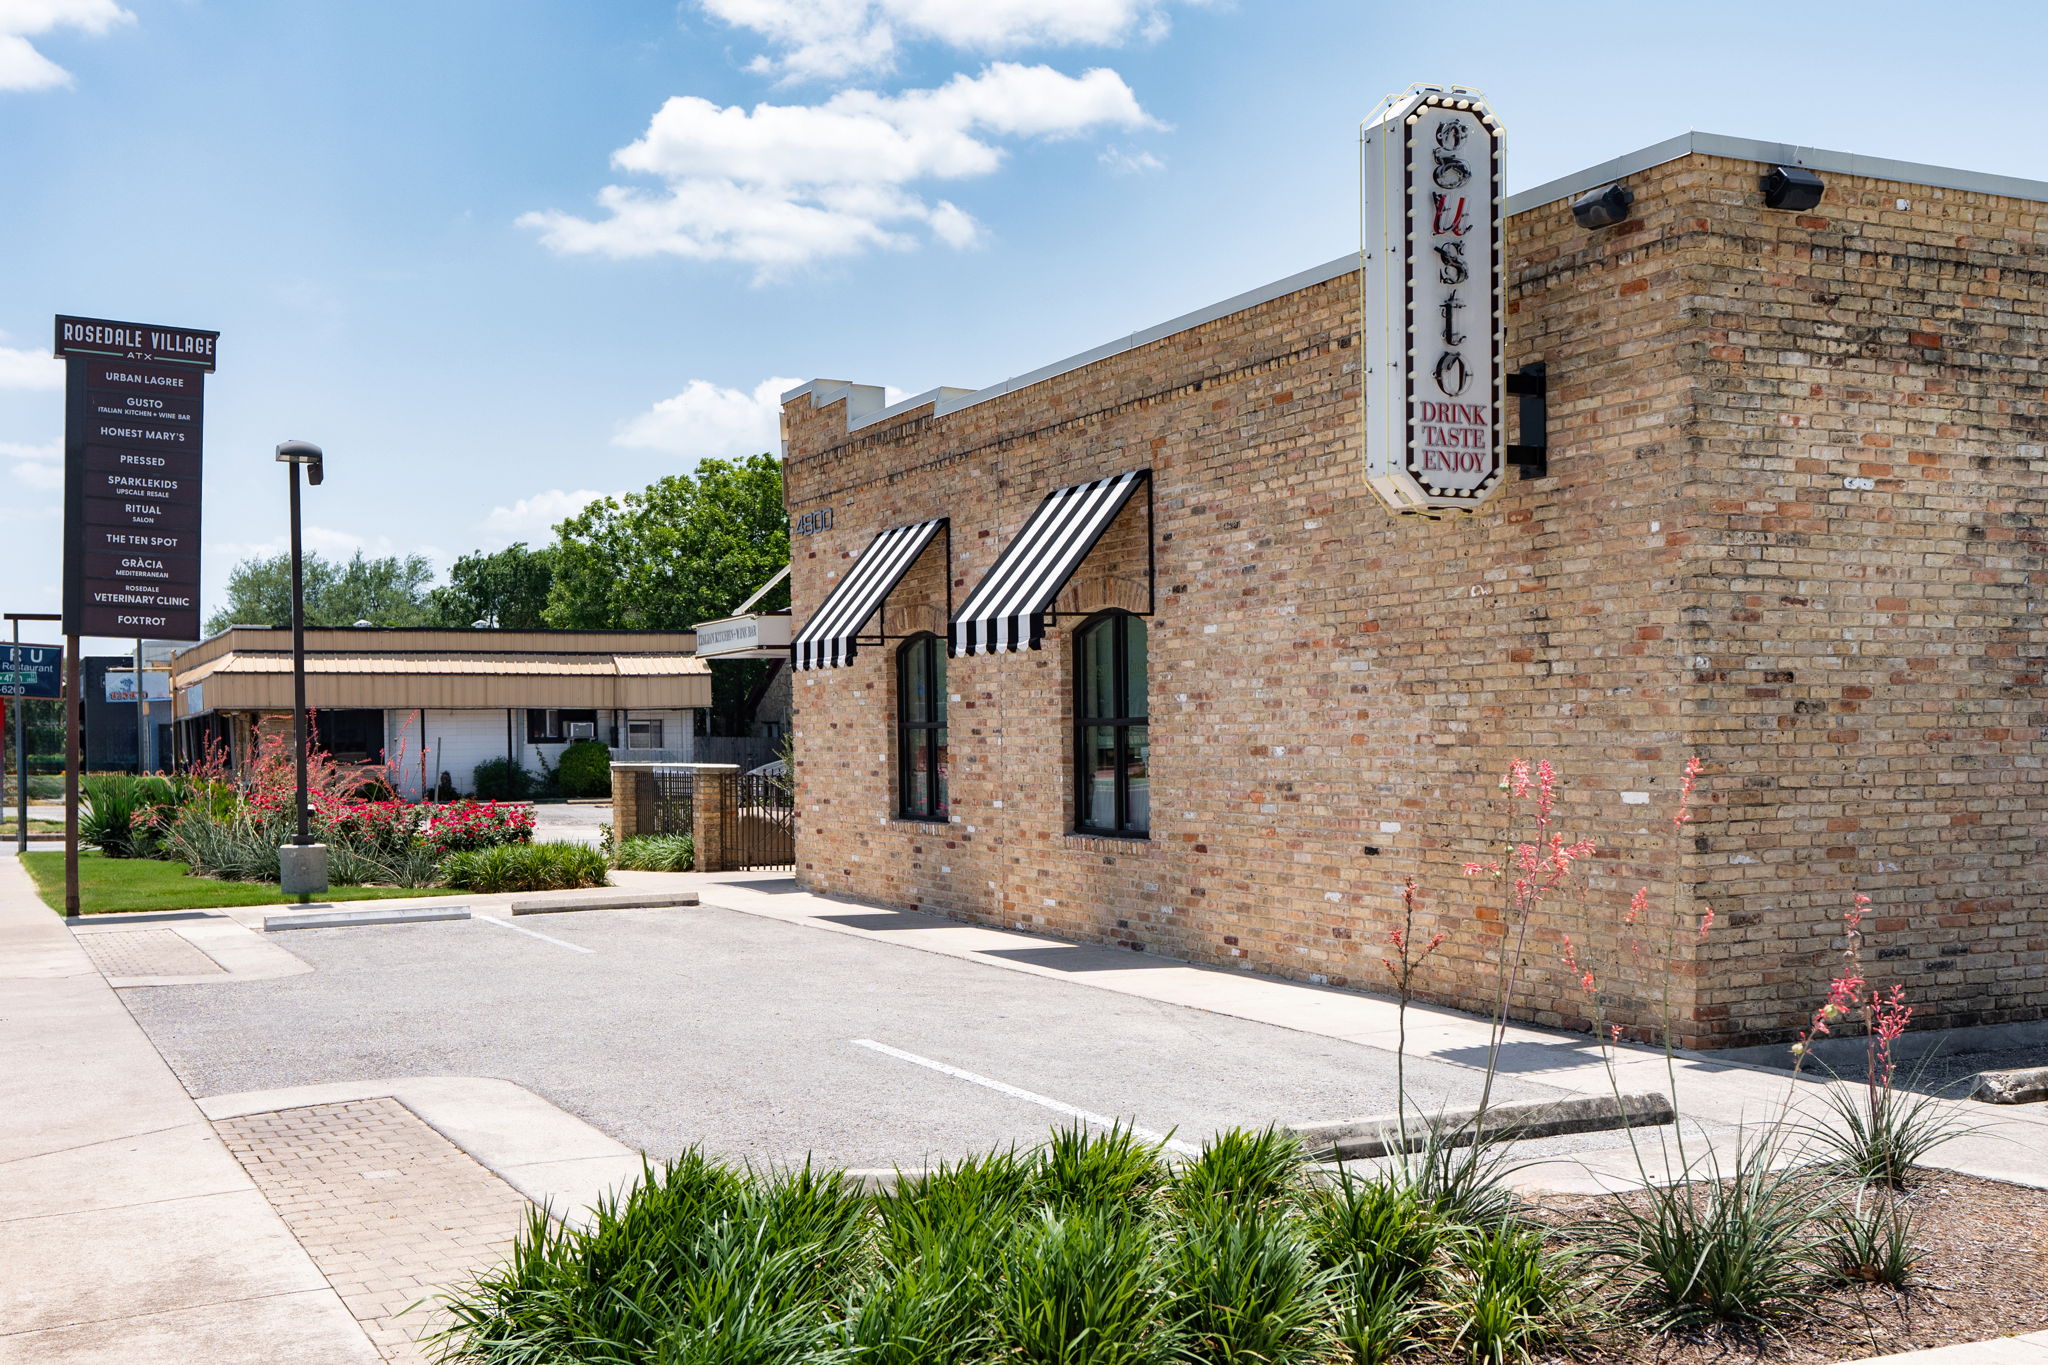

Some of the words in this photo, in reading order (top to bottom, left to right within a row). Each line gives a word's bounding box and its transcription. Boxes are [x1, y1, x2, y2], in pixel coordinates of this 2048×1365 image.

[64, 323, 142, 348] ROSEDALE
[151, 332, 213, 355] VILLAGE
[126, 352, 152, 360] ATX
[106, 372, 142, 384] URBAN
[144, 376, 184, 388] LAGREE
[126, 397, 164, 410] GUSTO
[98, 406, 122, 414] ITALIAN
[124, 408, 152, 416] KITCHEN
[158, 412, 176, 420] WINE
[1420, 401, 1488, 426] DRINK
[100, 426, 144, 438] HONEST
[146, 430, 184, 442] MARY'S
[1422, 425, 1486, 449] TASTE
[120, 454, 166, 466] PRESSED
[1422, 449, 1486, 474] ENJOY
[107, 475, 178, 489] SPARKLEKIDS
[116, 488, 144, 496] UPSCALE
[146, 490, 170, 498] RESALE
[126, 504, 162, 514] RITUAL
[796, 508, 833, 536] 4800
[106, 534, 126, 544] THE
[128, 536, 148, 544] TEN
[150, 536, 178, 546] SPOT
[116, 570, 168, 578] MEDITERRANEAN
[126, 584, 160, 592] ROSEDALE
[94, 592, 154, 604] VETERINARY
[156, 596, 190, 606] CLINIC
[118, 616, 166, 626] FOXTROT
[2, 662, 53, 672] Retaurant
